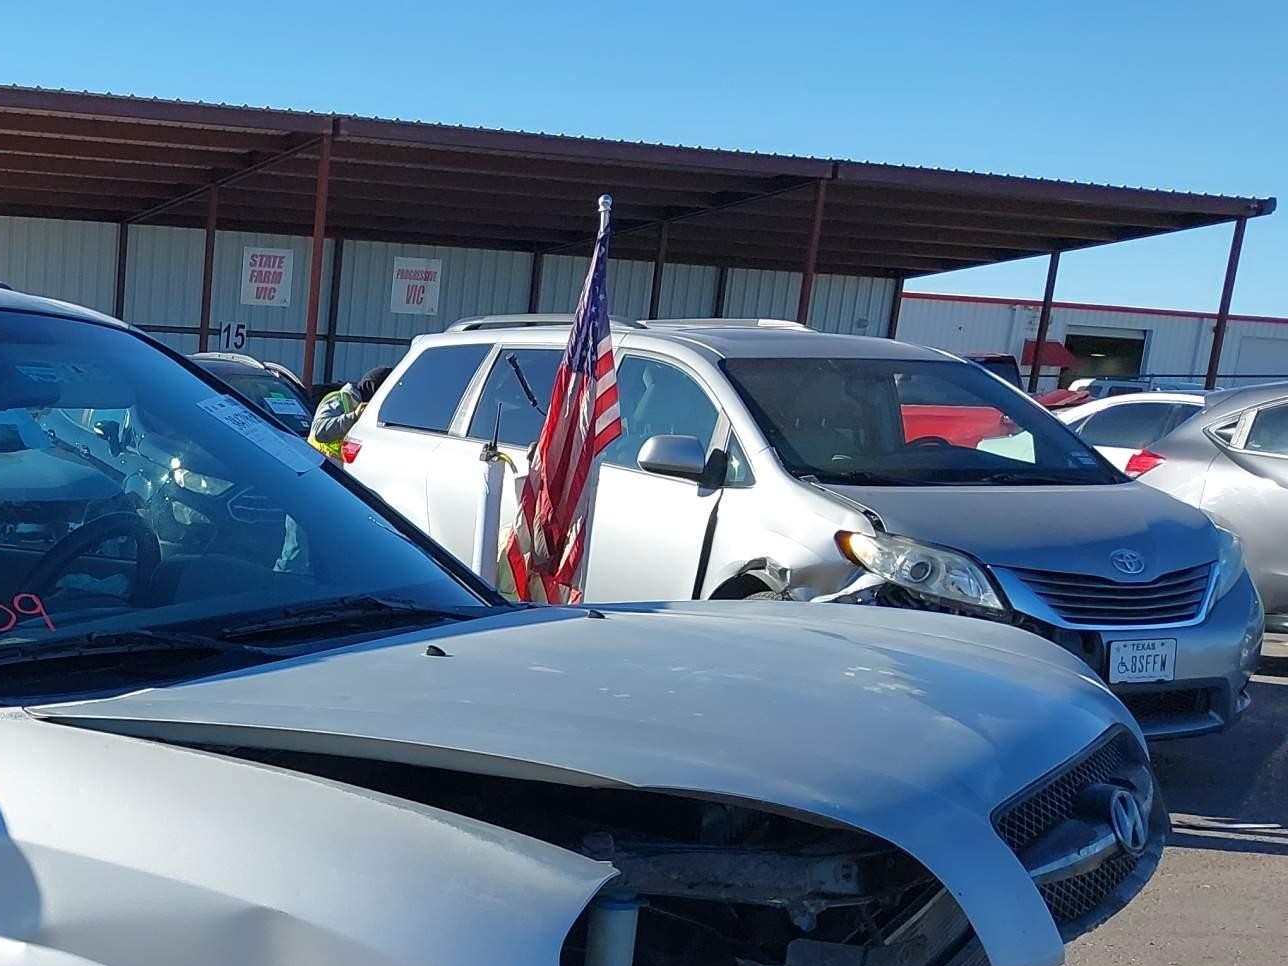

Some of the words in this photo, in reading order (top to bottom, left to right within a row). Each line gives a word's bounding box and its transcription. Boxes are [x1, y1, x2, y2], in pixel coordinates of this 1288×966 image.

[249, 254, 285, 269] STATE
[249, 270, 283, 284] FARM
[255, 286, 277, 300] VIC
[405, 284, 425, 305] VIC
[222, 323, 246, 349] 15
[1132, 642, 1156, 651] TEXAS
